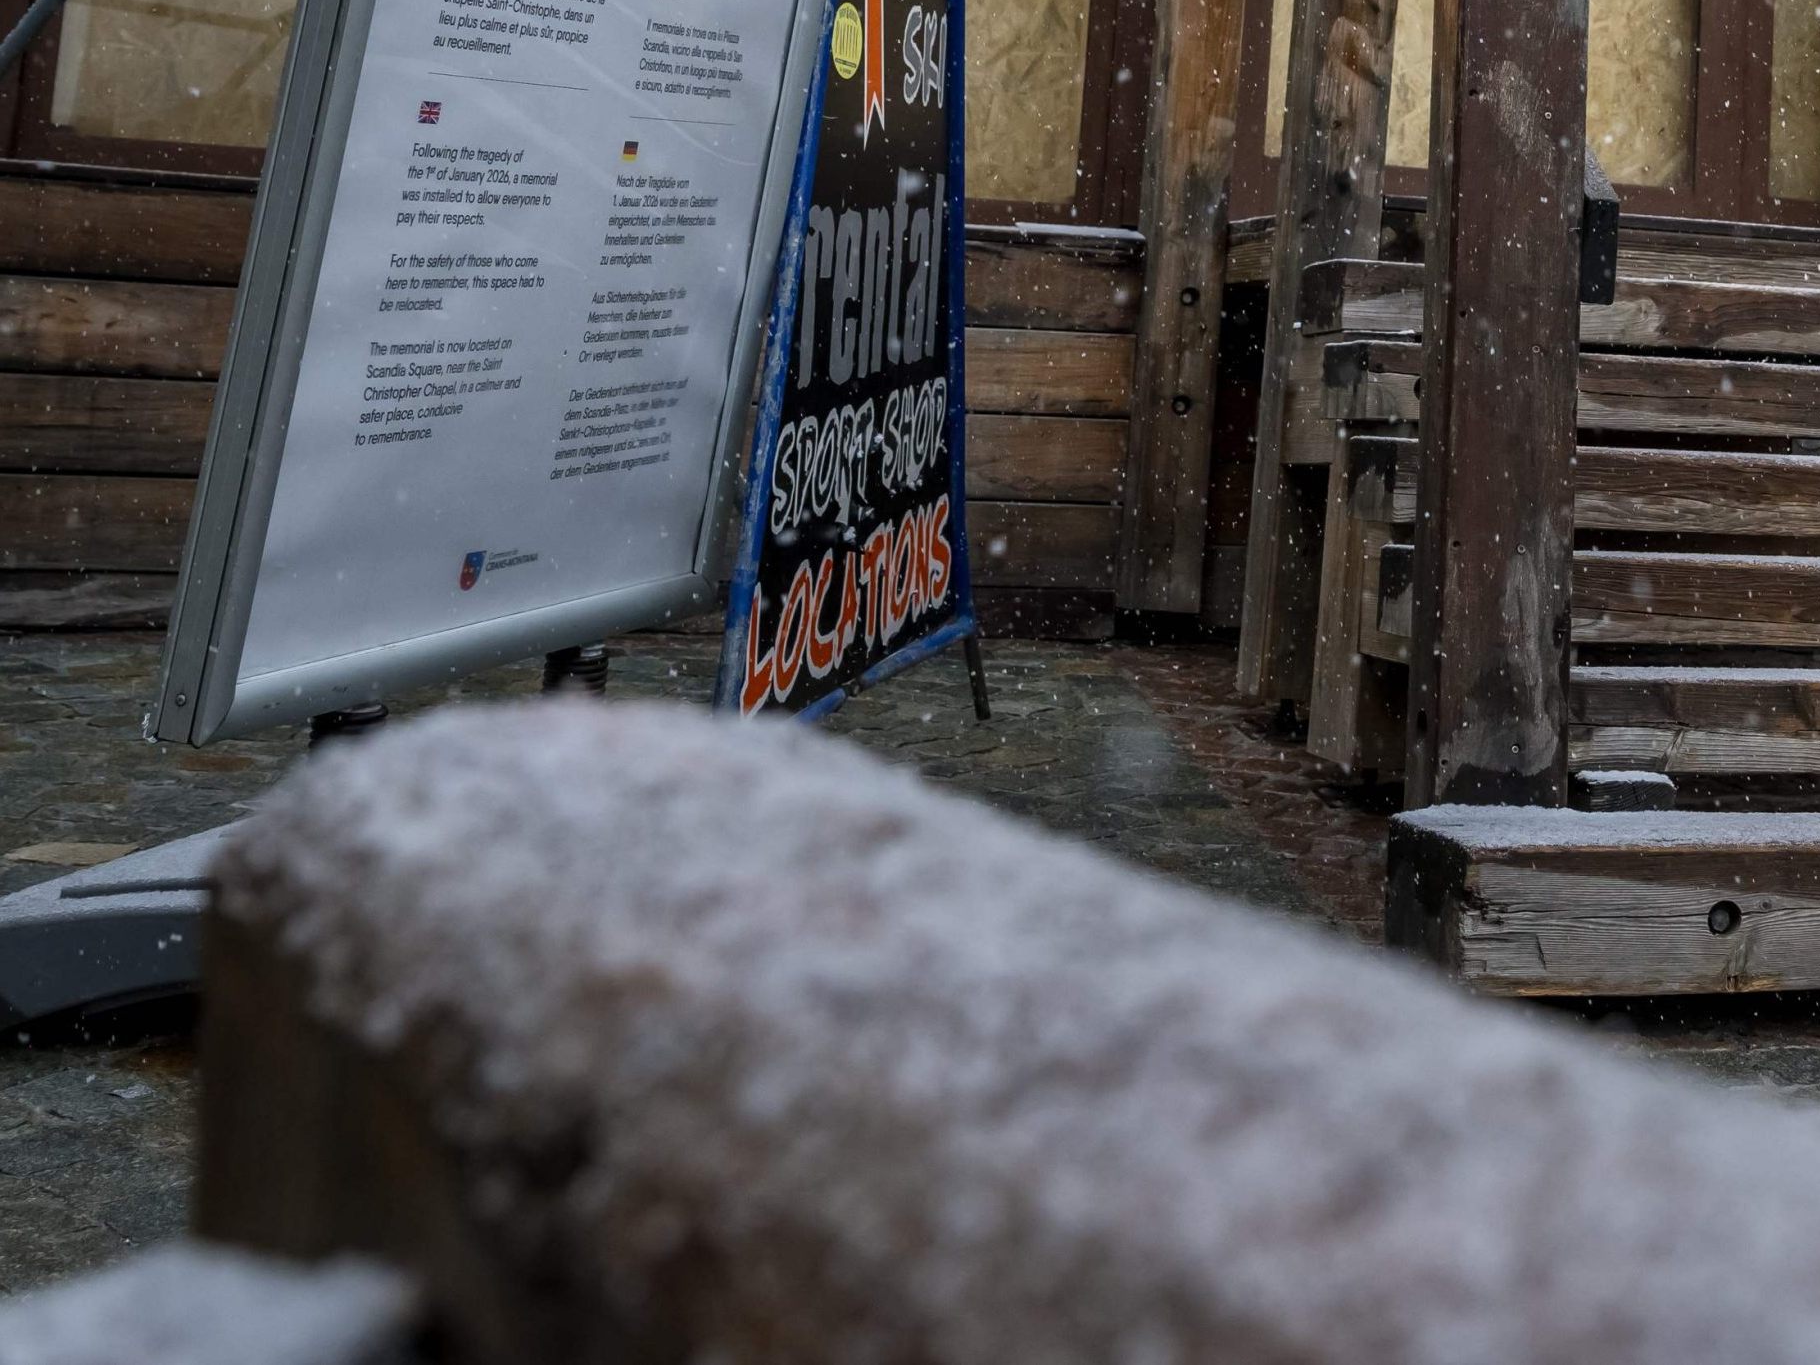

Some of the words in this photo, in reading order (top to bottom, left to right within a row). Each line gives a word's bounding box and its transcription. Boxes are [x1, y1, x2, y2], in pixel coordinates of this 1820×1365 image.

[564, 8, 583, 22] dans
[585, 13, 594, 23] un
[439, 10, 456, 25] lieu
[457, 14, 478, 29] plus
[480, 18, 507, 32] calme
[509, 22, 519, 34] et
[519, 23, 538, 38] plus
[556, 30, 588, 44] propice
[433, 35, 446, 47] au
[903, 6, 947, 109] SKI
[413, 143, 458, 162] Following
[460, 146, 475, 160] the
[477, 148, 512, 164] tragedy
[513, 149, 524, 162] of
[408, 165, 424, 179] the
[436, 167, 448, 180] of
[449, 168, 485, 185] January
[513, 174, 519, 184] a
[521, 173, 558, 185] memorial
[402, 190, 420, 201] was
[423, 188, 463, 202] installed
[465, 190, 475, 203] to
[477, 190, 501, 204] allow
[502, 195, 540, 207] everyone
[542, 194, 551, 206] to
[396, 212, 416, 226] pay
[418, 210, 440, 224] their
[390, 253, 407, 267] For
[409, 254, 425, 267] the
[427, 254, 454, 270] safety
[455, 253, 467, 267] of
[467, 254, 492, 267] those
[495, 254, 513, 267] who
[515, 257, 538, 267] come
[385, 276, 408, 289] here
[409, 276, 420, 289] to
[472, 275, 489, 288] this
[491, 278, 517, 290] space
[519, 275, 535, 288] had
[536, 275, 545, 287] to
[798, 167, 945, 389] rental
[379, 298, 394, 312] be
[371, 342, 388, 355] The
[390, 340, 435, 355] memorial
[437, 340, 445, 353] is
[447, 342, 466, 352] now
[468, 337, 501, 351] located
[501, 339, 512, 349] on
[366, 363, 406, 378] Scandia
[446, 363, 466, 373] near
[467, 360, 481, 372] the
[482, 358, 503, 371] Saint
[364, 386, 421, 401] Christopher
[459, 381, 467, 393] in
[468, 383, 474, 393] a
[504, 376, 522, 389] and
[359, 409, 384, 423] safer
[418, 403, 463, 418] conducive
[355, 433, 366, 446] to
[771, 398, 875, 534] SPORT
[881, 377, 947, 489] SHOP
[740, 493, 951, 719] LOCATIONS
